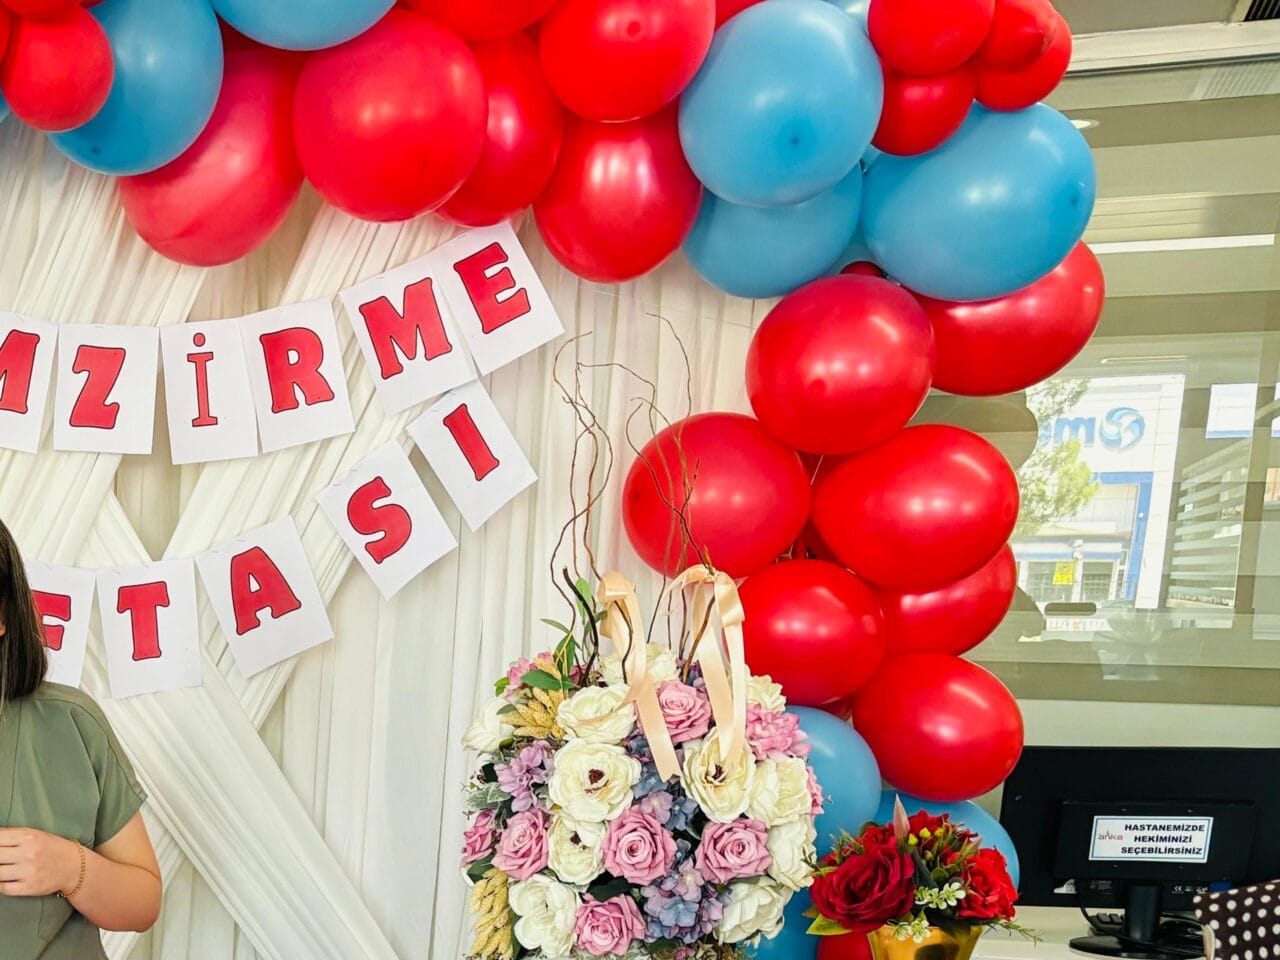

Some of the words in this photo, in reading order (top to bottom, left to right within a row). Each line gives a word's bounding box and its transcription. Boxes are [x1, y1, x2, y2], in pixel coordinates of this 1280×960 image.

[1124, 823, 1205, 832] HASTANEMİZDE
[1134, 834, 1192, 843] HEKİMİNİZİ
[1121, 845, 1202, 856] SEÇEBİLİRSİNİZ
